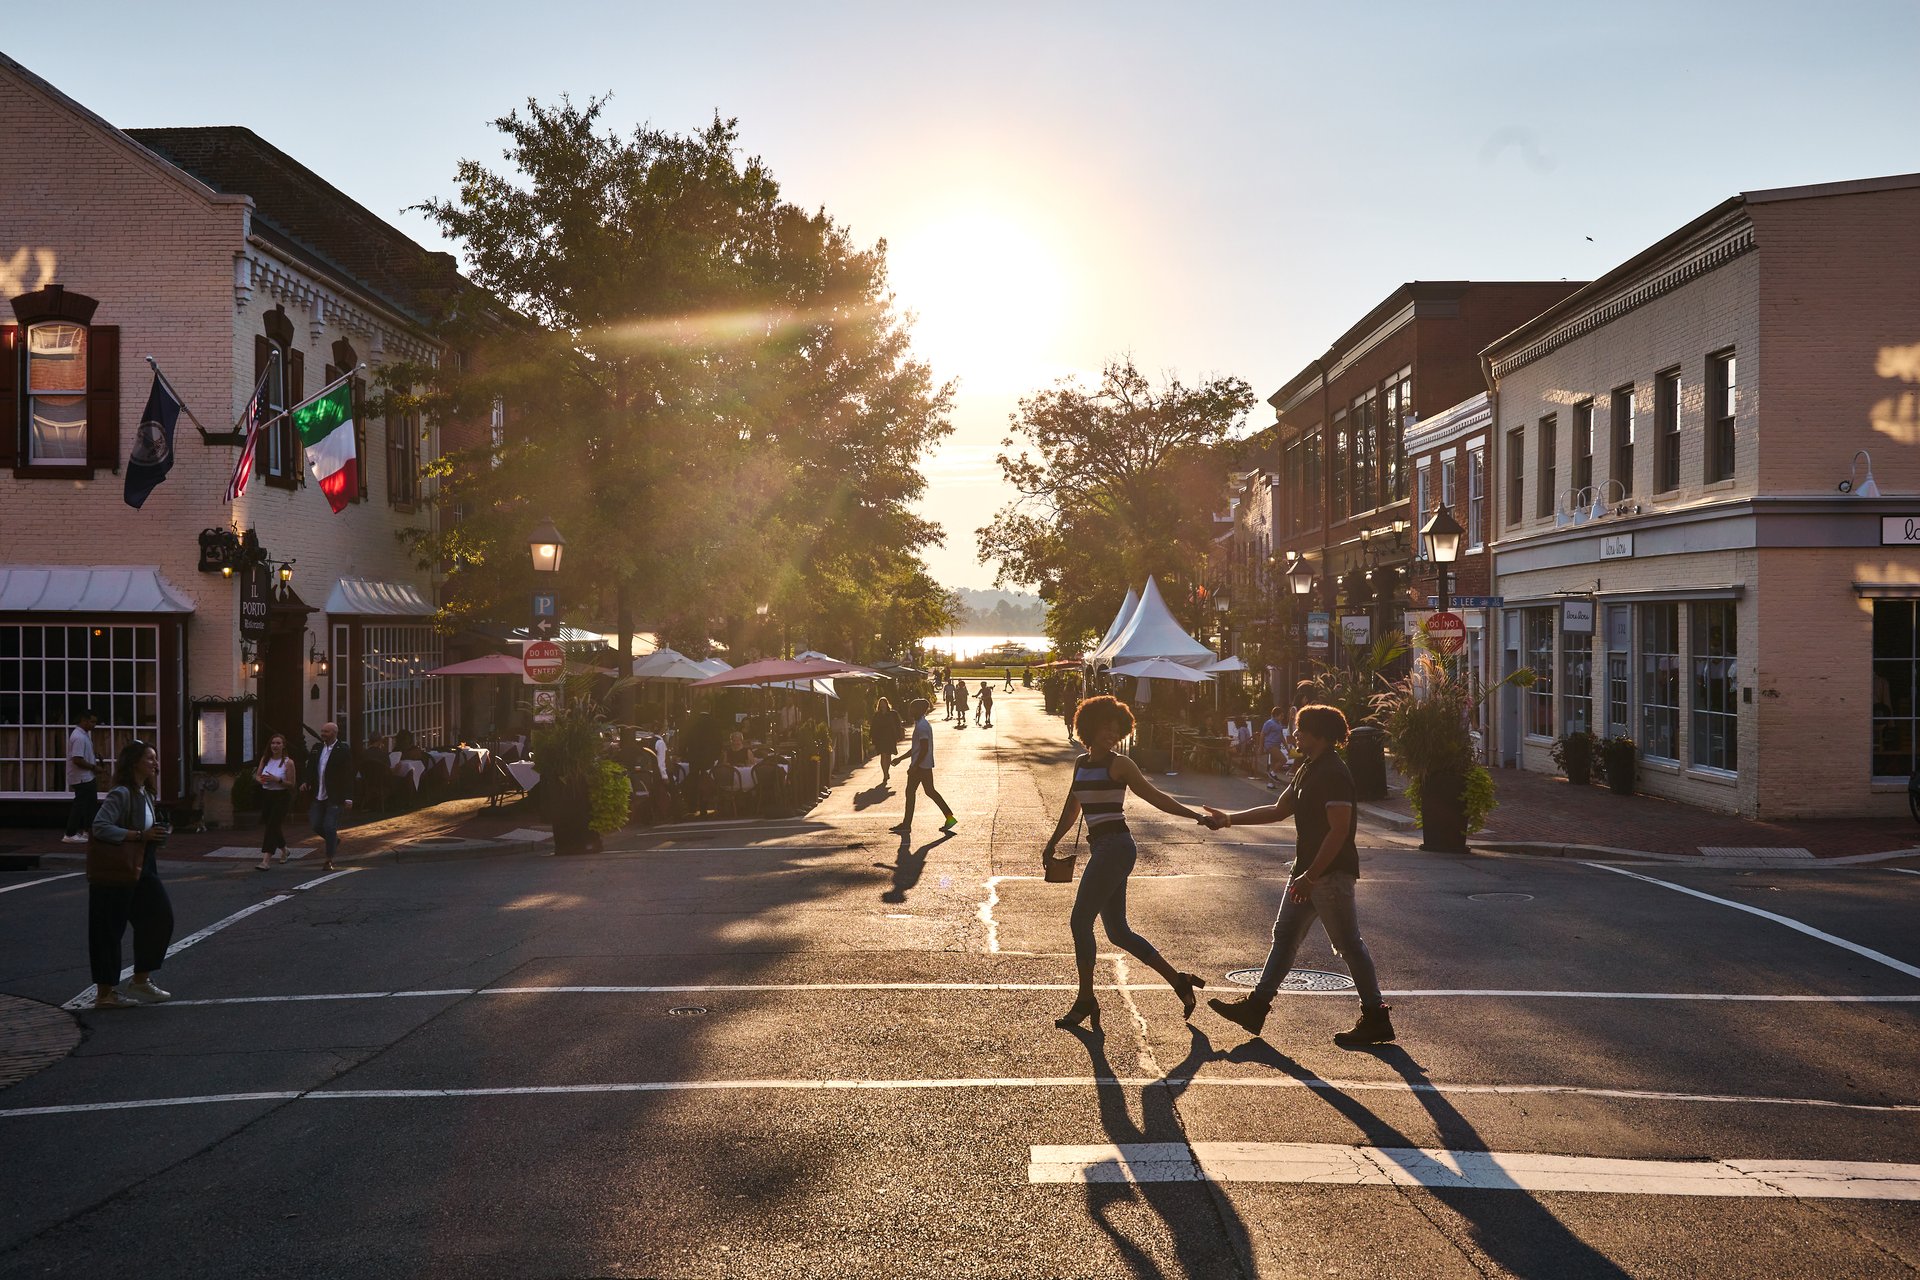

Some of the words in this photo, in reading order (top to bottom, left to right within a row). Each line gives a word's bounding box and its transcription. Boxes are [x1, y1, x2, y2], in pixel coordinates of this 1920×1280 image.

[251, 584, 259, 598] IL
[539, 597, 551, 614] P
[1461, 598, 1475, 606] LEE
[242, 601, 267, 616] PORTO
[1444, 620, 1459, 628] NOT
[532, 667, 556, 675] ENTER
